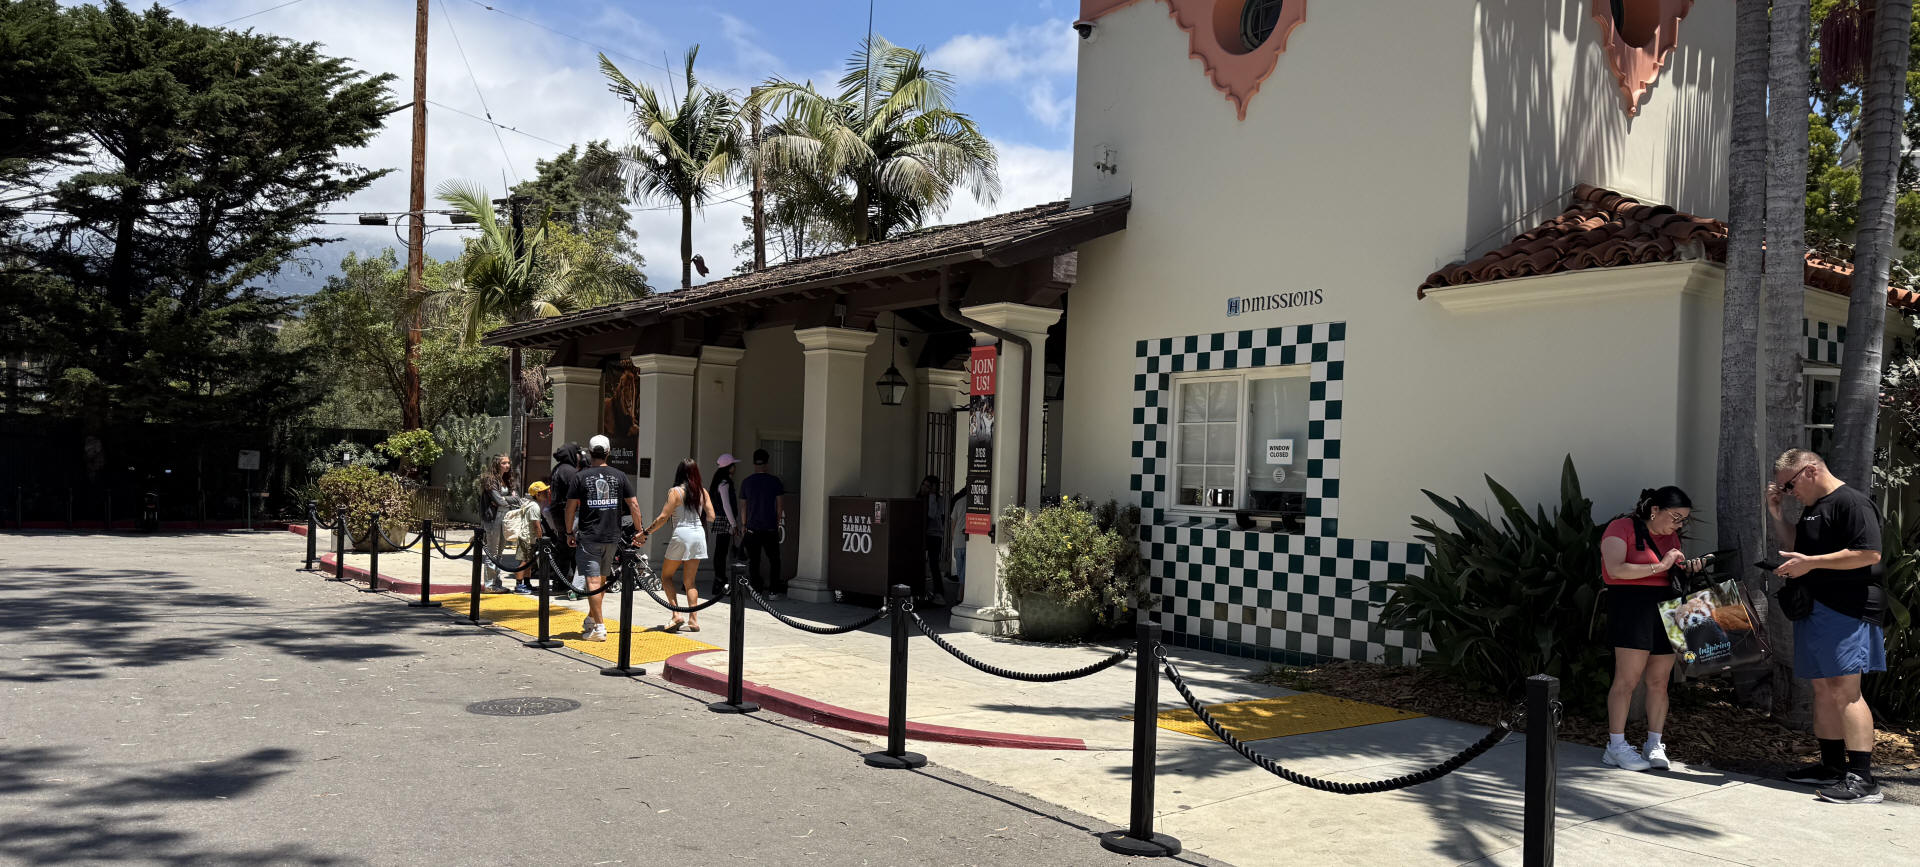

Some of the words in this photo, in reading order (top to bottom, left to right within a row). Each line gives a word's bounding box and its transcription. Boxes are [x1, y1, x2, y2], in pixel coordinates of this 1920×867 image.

[972, 358, 994, 375] JOIN
[976, 375, 990, 391] US!
[842, 514, 872, 525] SANTA
[842, 523, 872, 533] BARBARA
[842, 532, 873, 554] ZOO
[1698, 641, 1731, 656] Inspiring
